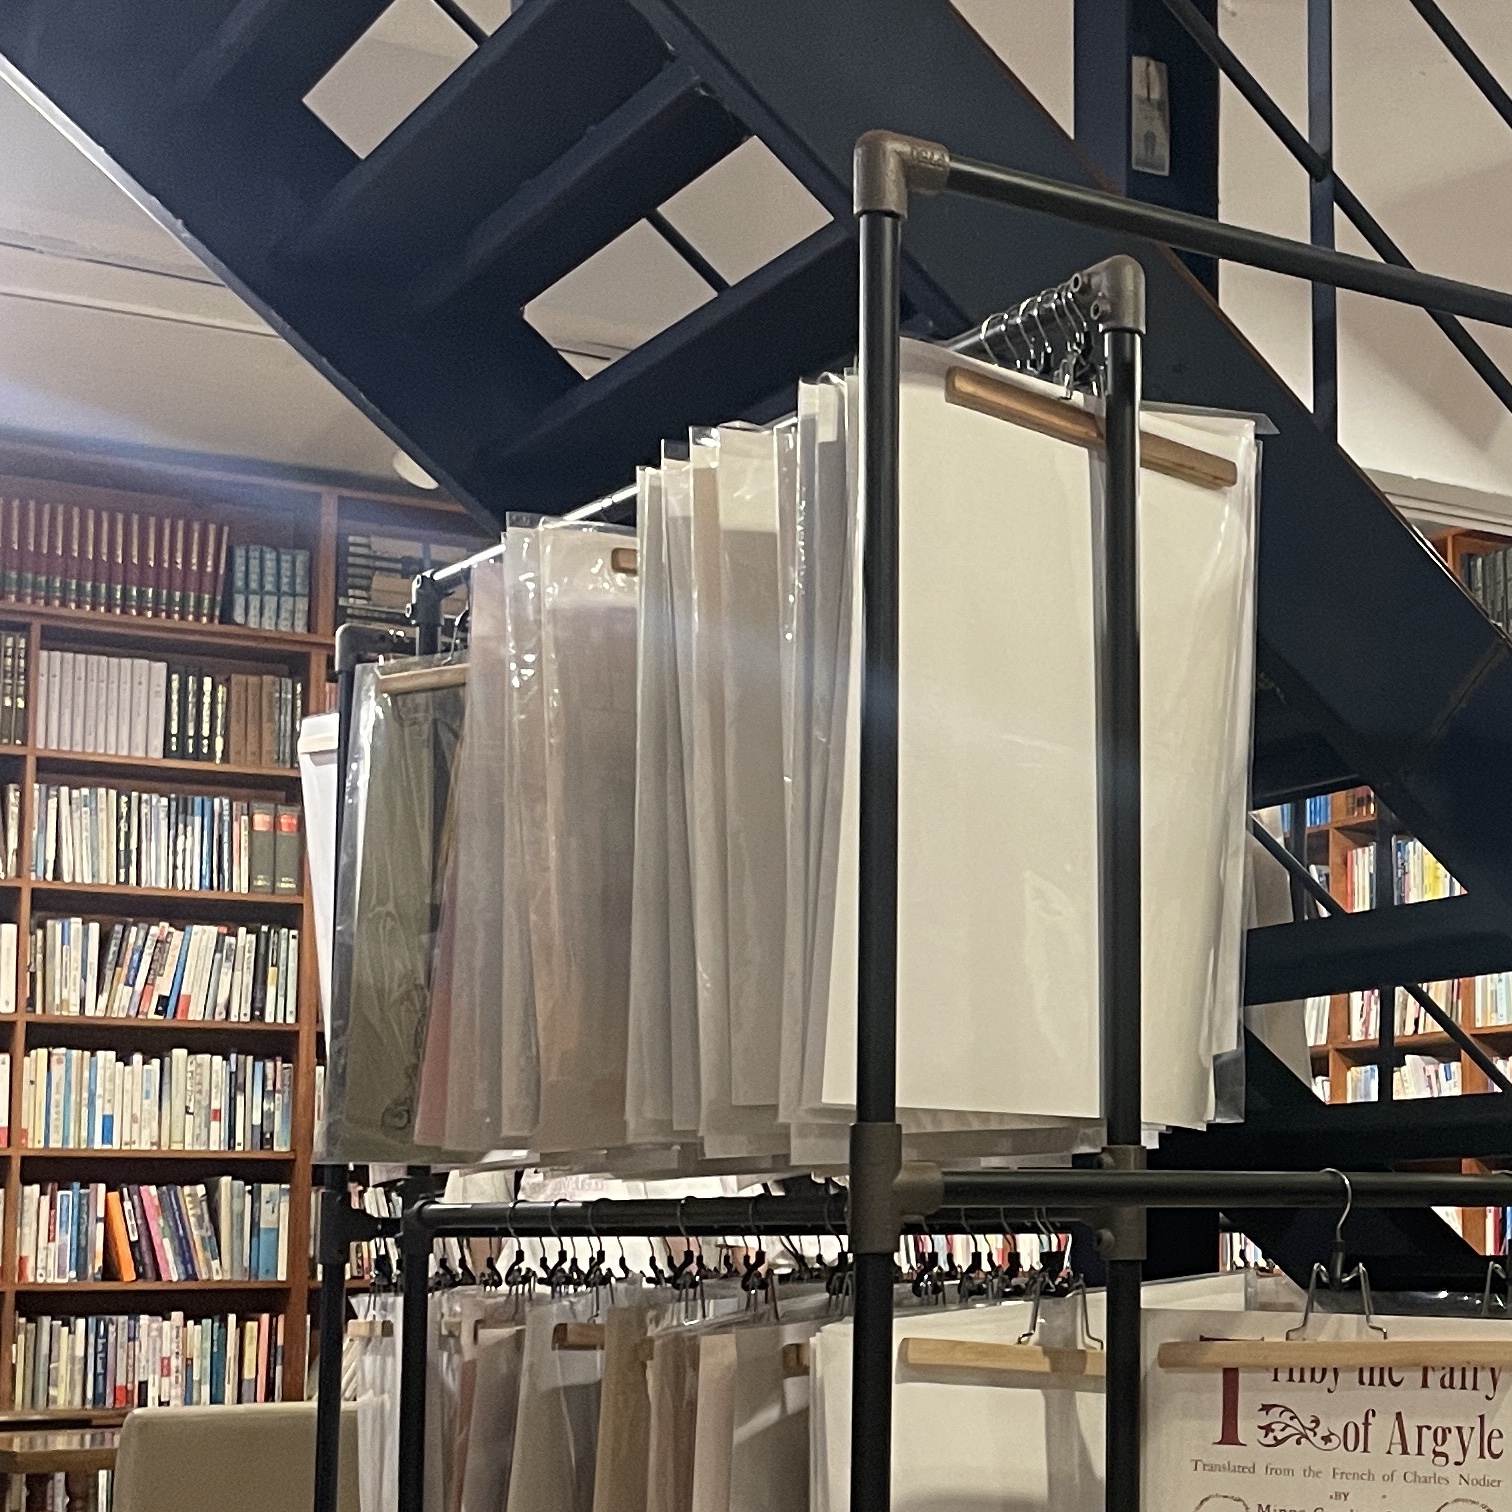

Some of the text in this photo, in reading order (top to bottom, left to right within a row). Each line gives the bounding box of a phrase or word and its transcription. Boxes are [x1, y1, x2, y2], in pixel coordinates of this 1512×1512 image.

[1342, 1408, 1504, 1468] of Argyle
[1190, 1458, 1503, 1488] Translated from the French of Charles Nodier
